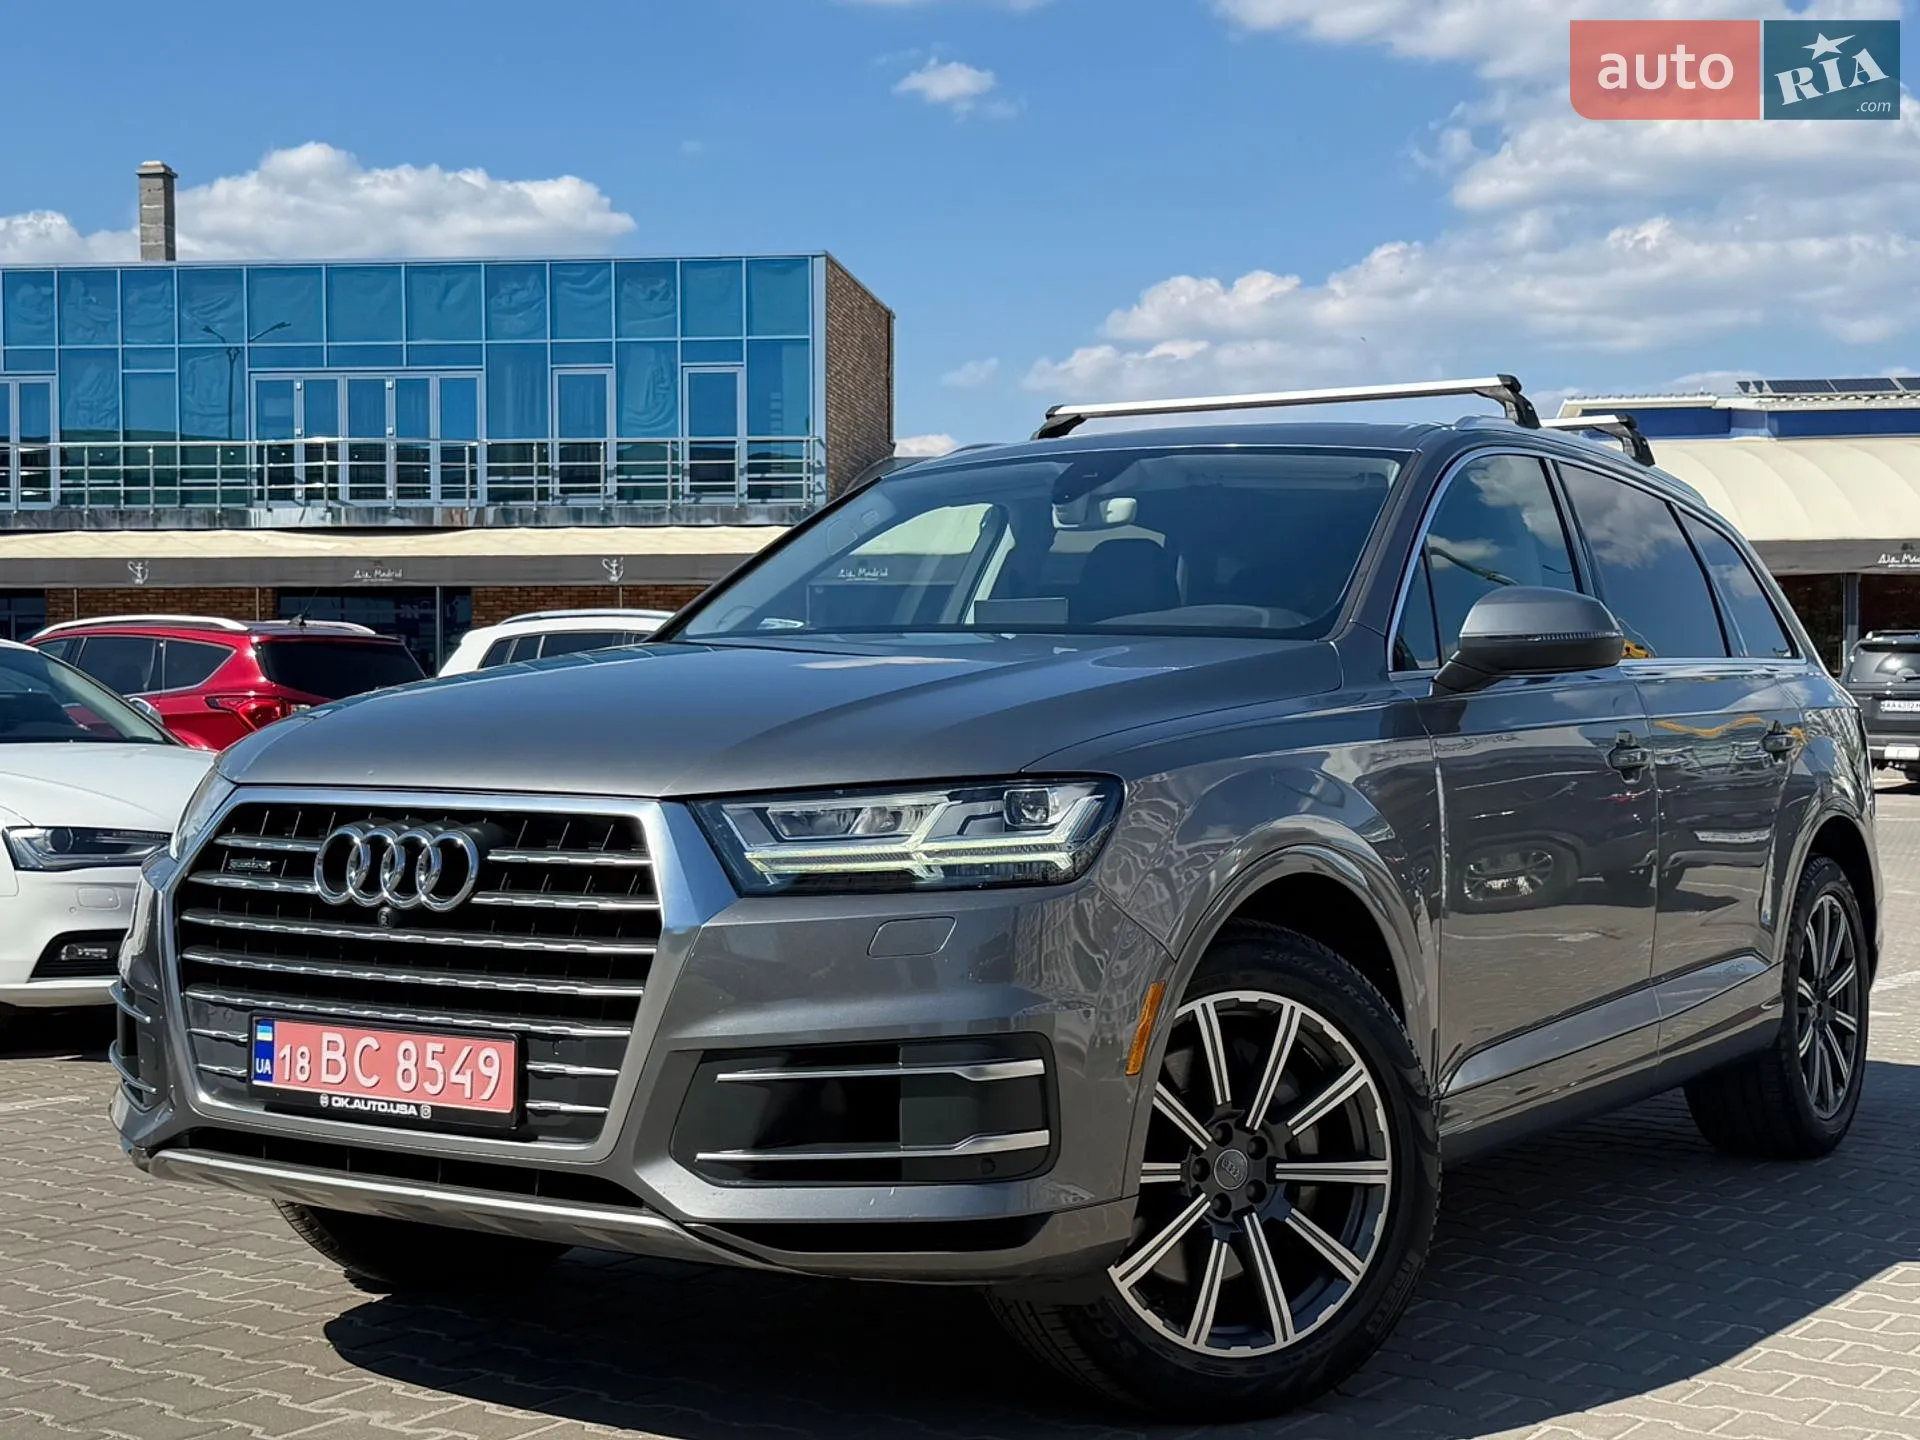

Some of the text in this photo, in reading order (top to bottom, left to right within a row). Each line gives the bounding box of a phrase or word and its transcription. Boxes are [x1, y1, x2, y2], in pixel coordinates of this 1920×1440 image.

[255, 1058, 272, 1075] UA
[278, 1031, 502, 1101] 18 BC 8549
